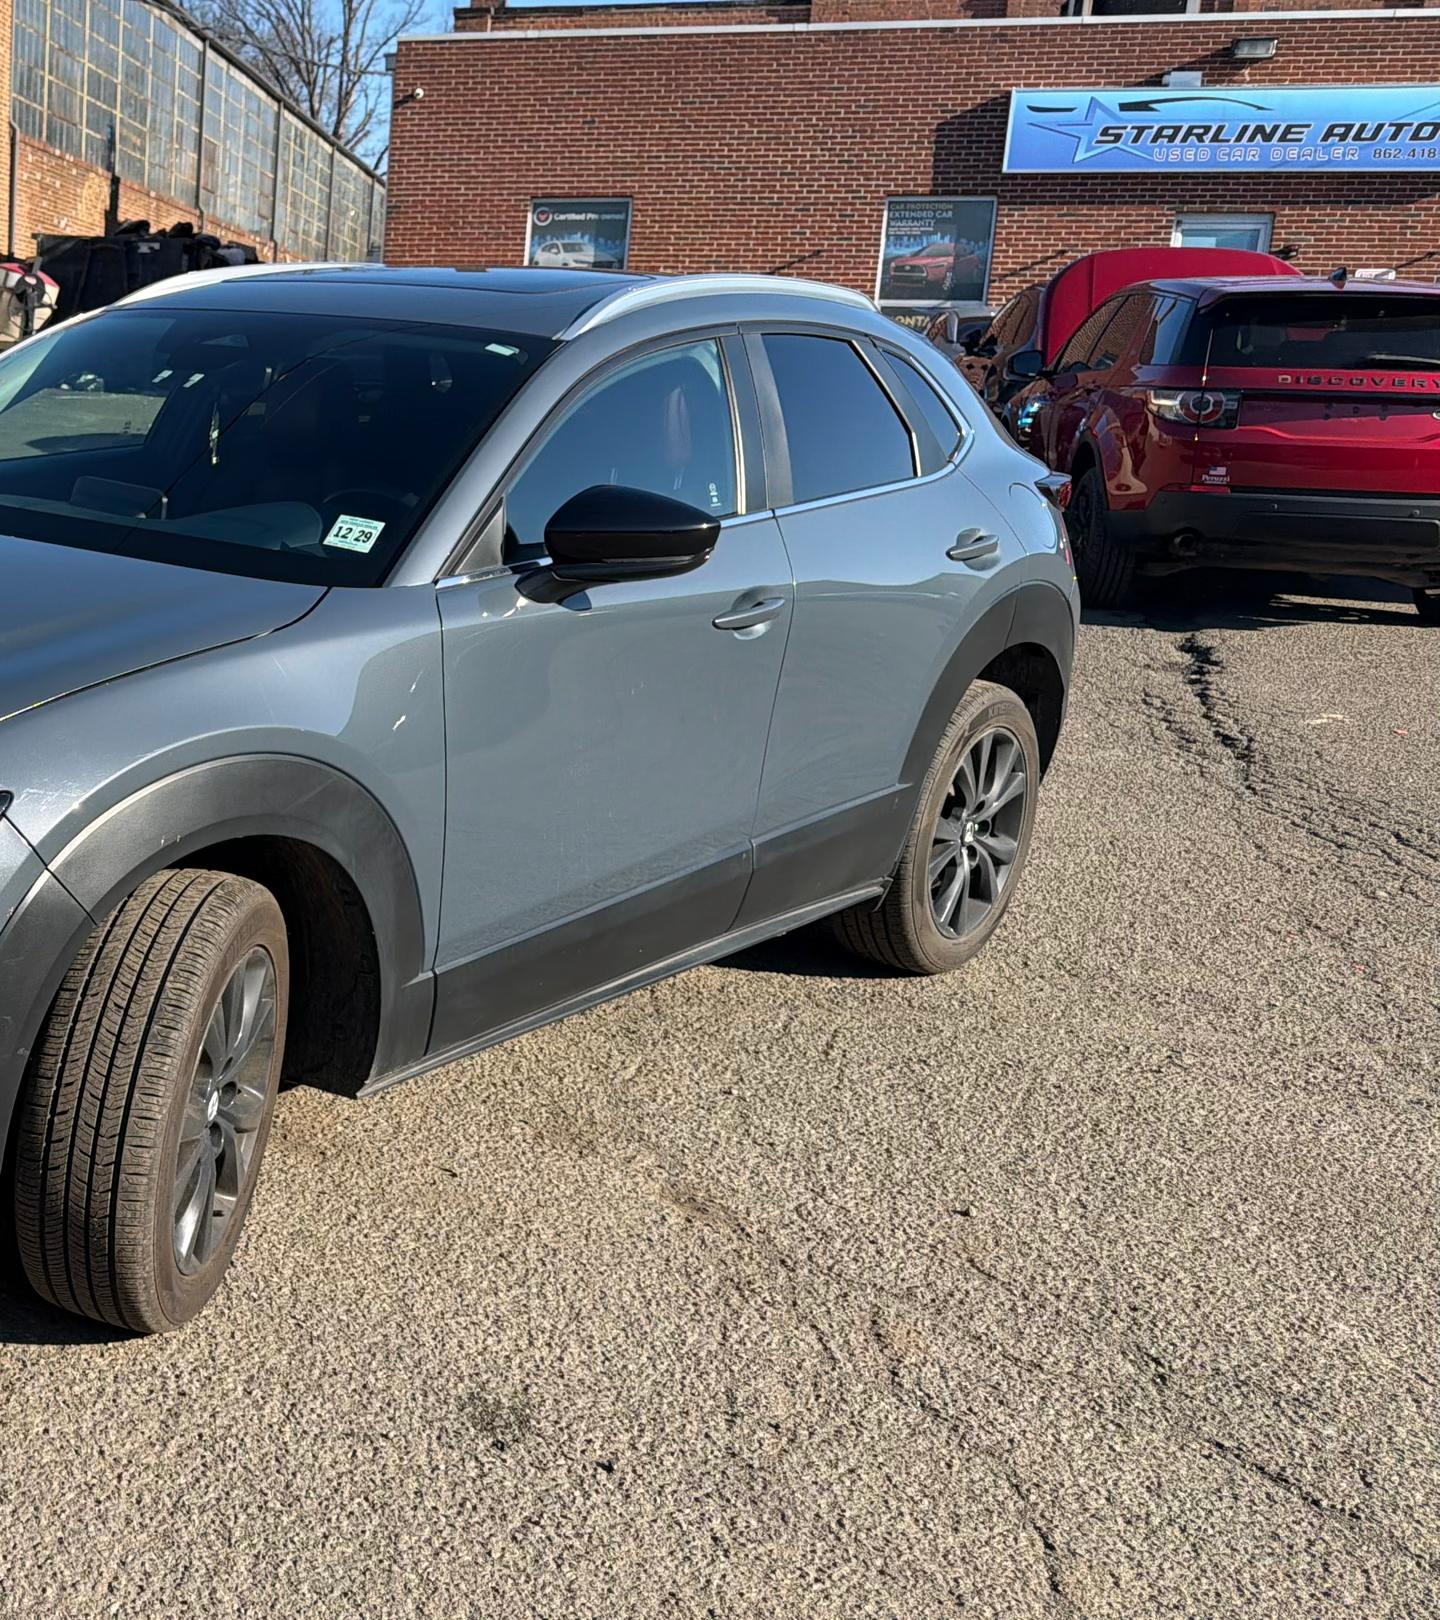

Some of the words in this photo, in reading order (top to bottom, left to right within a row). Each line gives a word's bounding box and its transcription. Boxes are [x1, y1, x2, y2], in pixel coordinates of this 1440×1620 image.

[1094, 123, 1312, 145] STARLINE
[1319, 121, 1440, 143] AUTO
[1153, 147, 1211, 161] USED
[1216, 147, 1260, 161] CAR
[1270, 147, 1359, 161] DEALER
[889, 210, 934, 218] EXTENDED
[935, 210, 953, 218] CAR
[889, 219, 936, 227] WARRANTY
[333, 525, 354, 540] 12
[352, 529, 374, 544] 29
